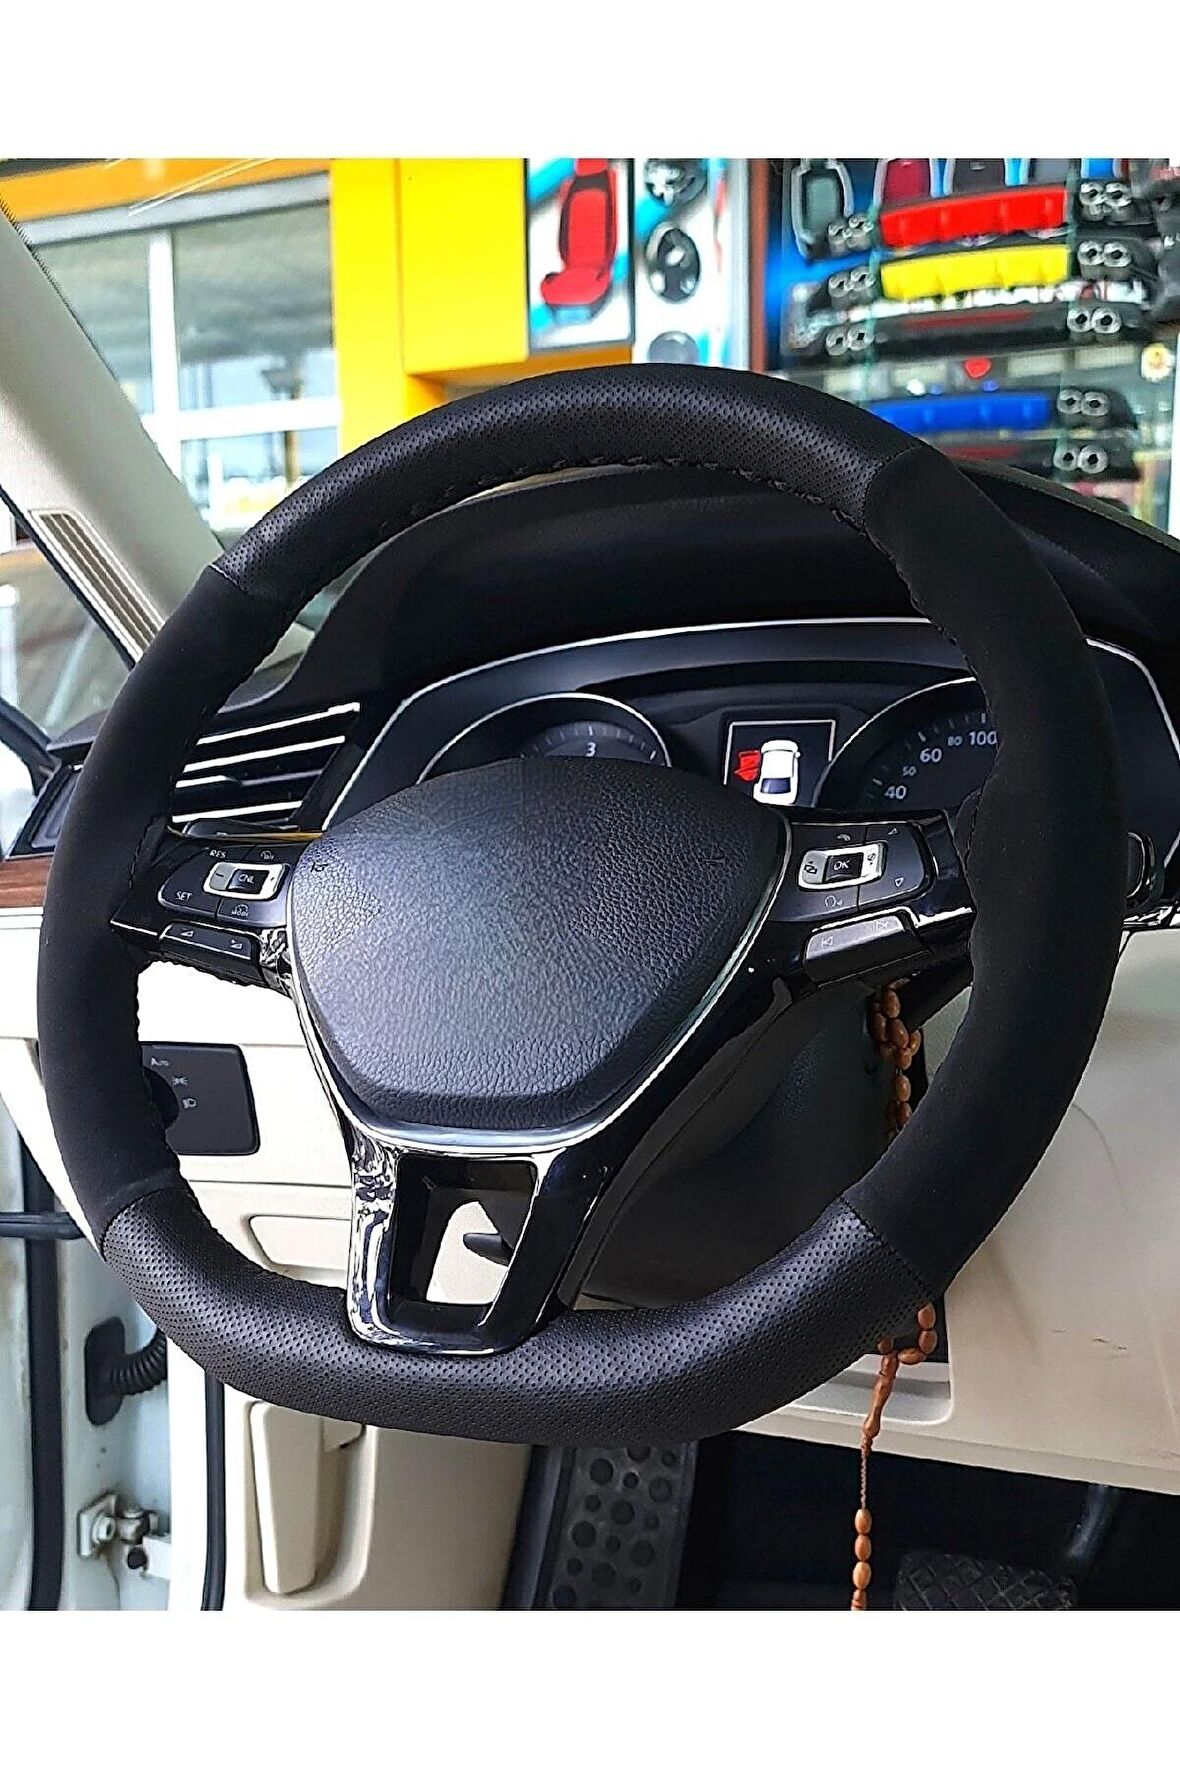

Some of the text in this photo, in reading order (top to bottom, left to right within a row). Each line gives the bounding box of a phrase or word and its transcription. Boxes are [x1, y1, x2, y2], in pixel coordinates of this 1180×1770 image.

[968, 731, 997, 745] 100
[586, 742, 597, 757] 3
[920, 748, 942, 762] 60
[902, 766, 917, 776] 50
[884, 785, 907, 800] 40
[833, 860, 850, 870] OK
[238, 873, 254, 884] CNL
[174, 891, 193, 901] SET
